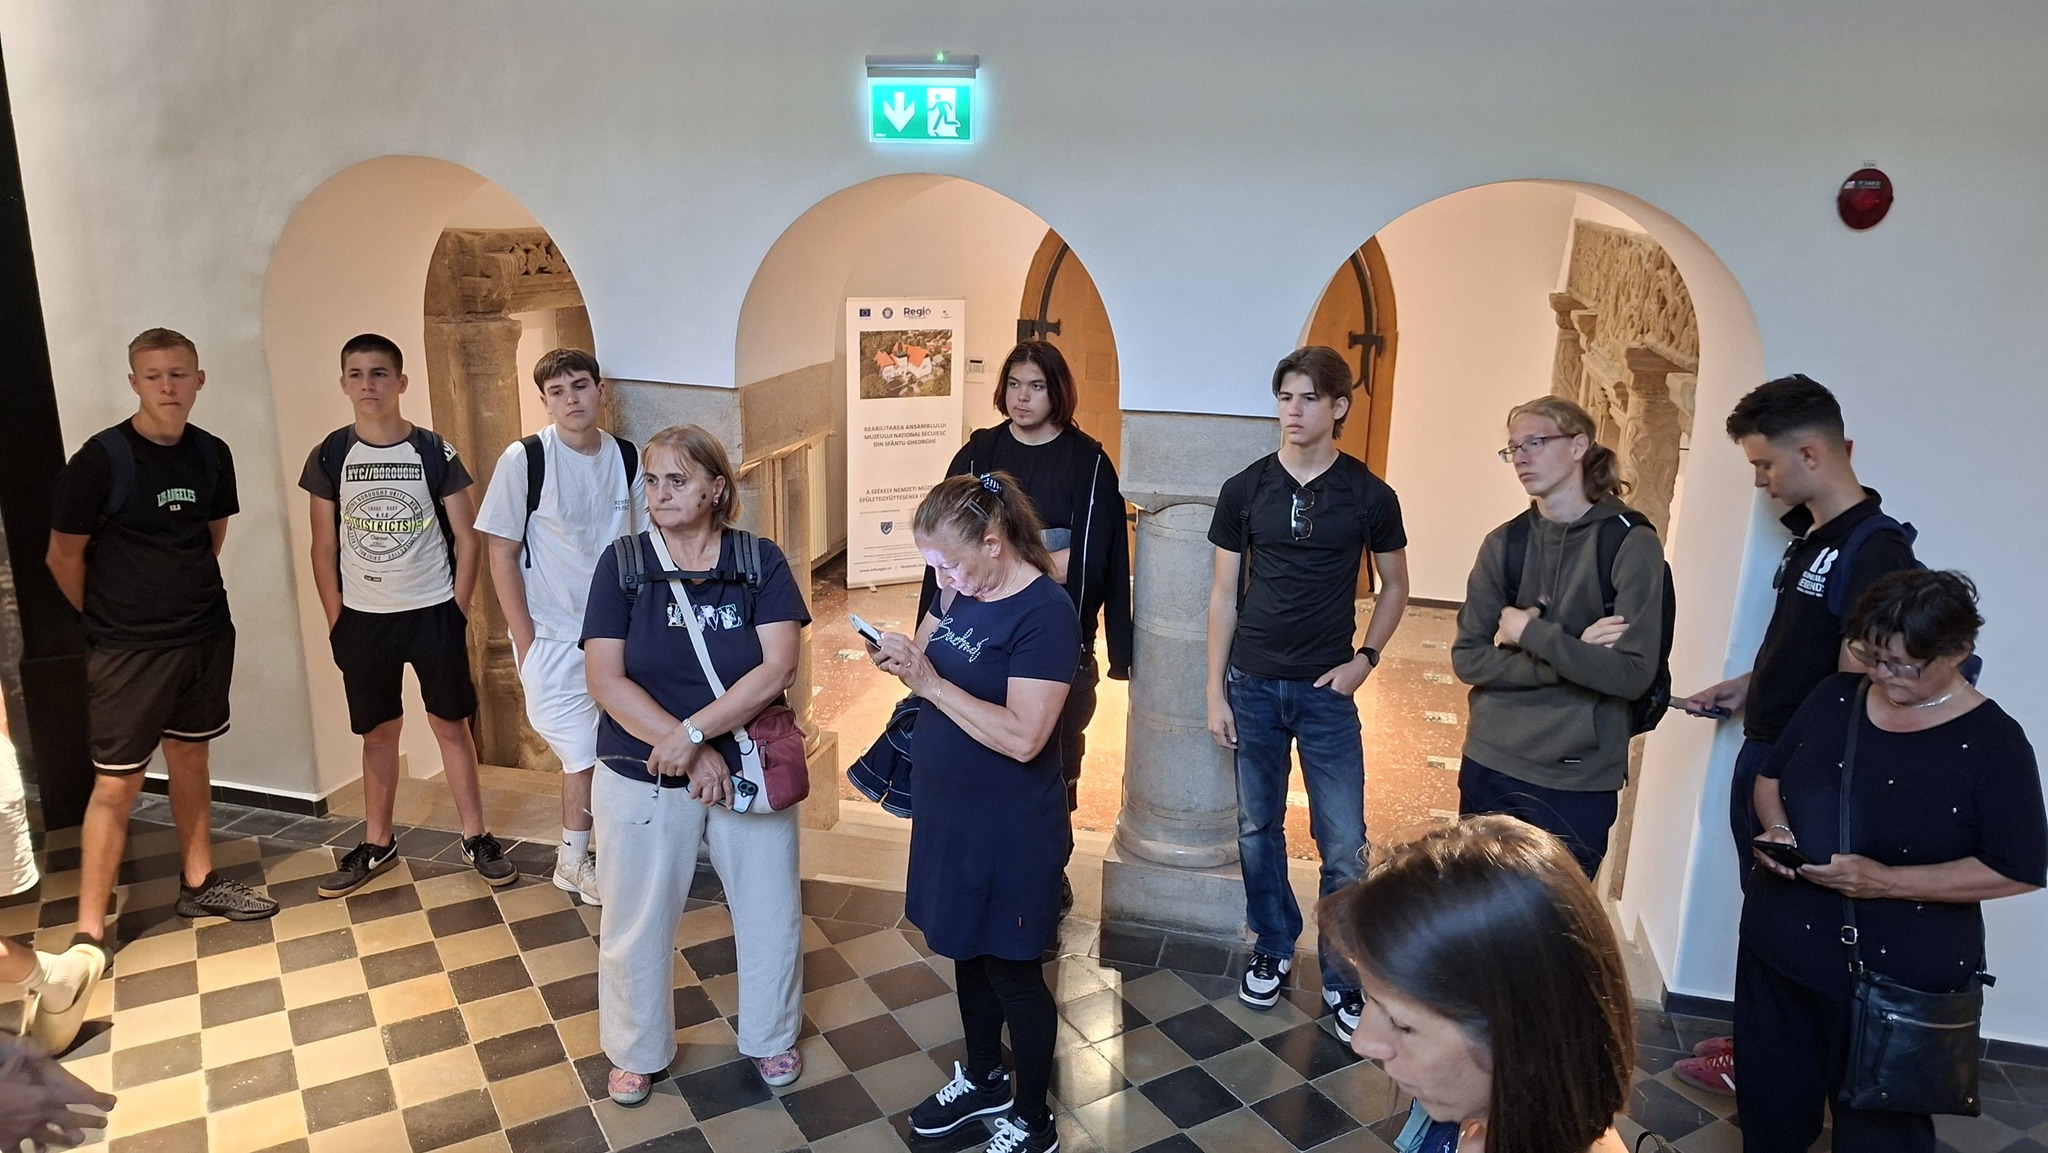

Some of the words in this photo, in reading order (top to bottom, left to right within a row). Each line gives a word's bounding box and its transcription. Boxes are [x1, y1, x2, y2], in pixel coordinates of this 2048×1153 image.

[903, 306, 932, 317] Regio
[906, 438, 937, 446] GHEORGHE
[871, 487, 893, 495] SZÉKELY
[893, 485, 918, 493] NEMZETI
